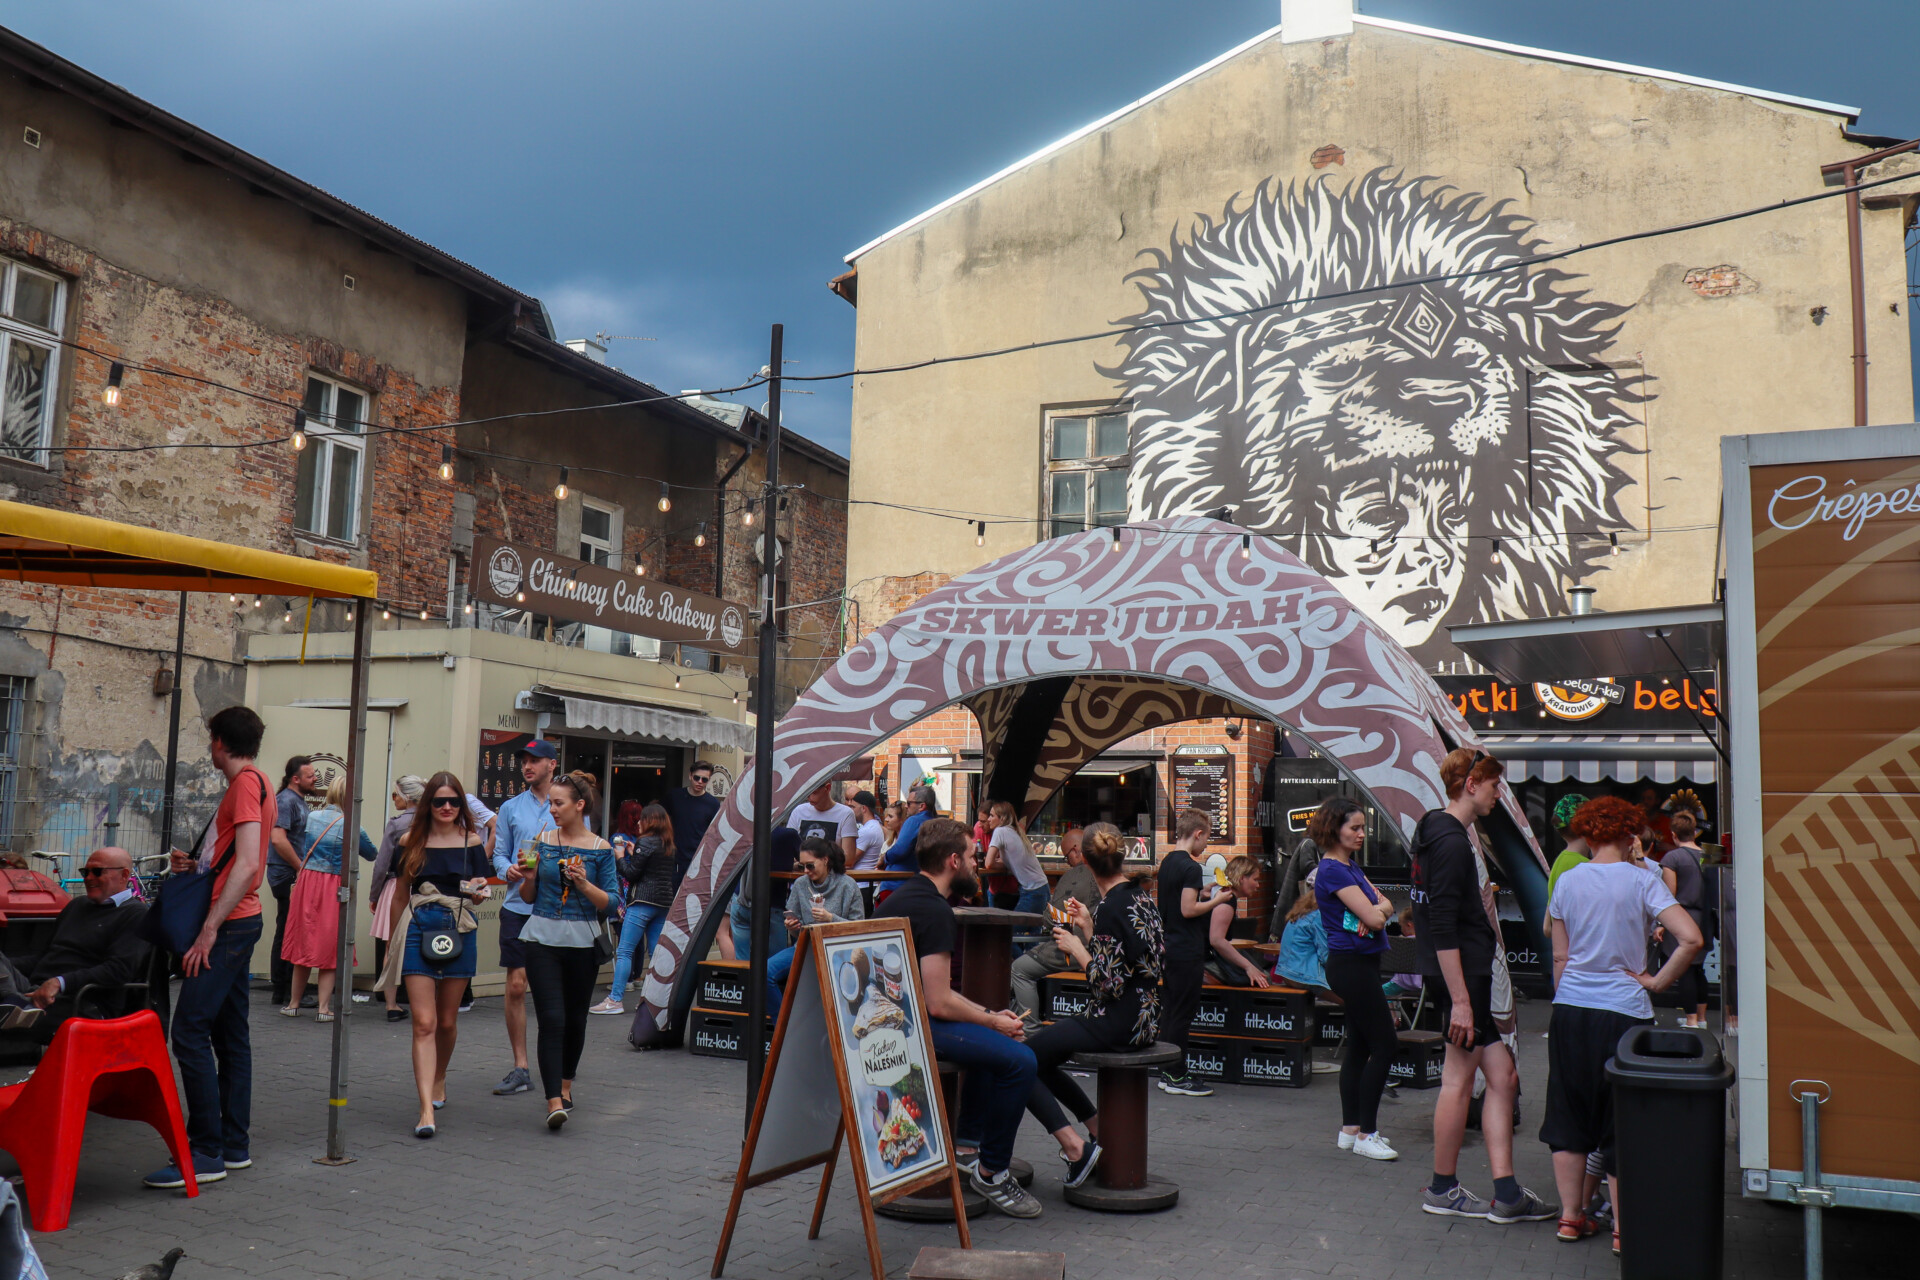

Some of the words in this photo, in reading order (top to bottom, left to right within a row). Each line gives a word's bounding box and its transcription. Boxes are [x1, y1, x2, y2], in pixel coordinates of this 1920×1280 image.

[1768, 475, 1920, 541] Crêpes
[529, 557, 609, 616] Chimney
[613, 579, 654, 618] Cake
[657, 591, 717, 640] Bakery
[918, 606, 1109, 636] SKWER
[1117, 592, 1303, 641] JUDAH
[1541, 688, 1550, 697] W
[1547, 698, 1595, 714] KRAKOWIE
[498, 714, 520, 728] MENU
[483, 732, 497, 741] Menu
[704, 982, 742, 1000] fritz-kola
[1245, 1012, 1292, 1031] fritz-kola
[696, 1031, 738, 1050] fritz-kola
[1243, 1058, 1291, 1076] fritz-kola
